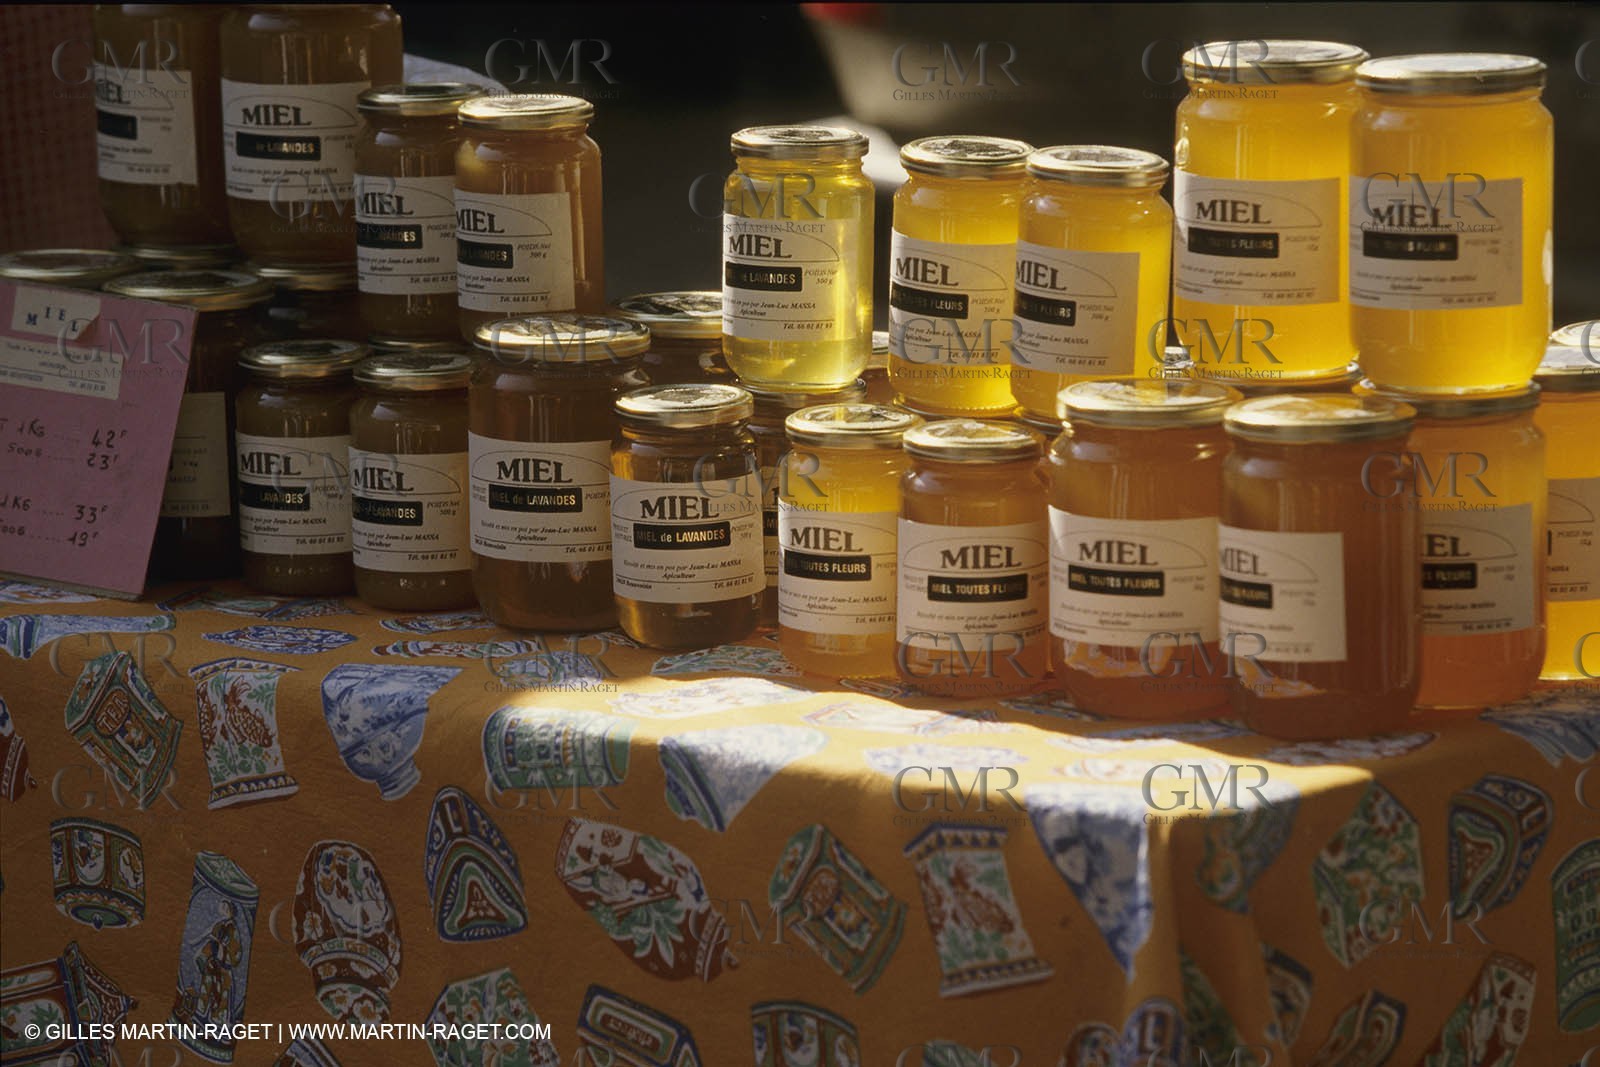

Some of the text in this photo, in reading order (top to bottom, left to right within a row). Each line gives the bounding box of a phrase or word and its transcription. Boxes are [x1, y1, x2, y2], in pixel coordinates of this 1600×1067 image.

[241, 104, 312, 126] MIEL
[456, 209, 505, 233] MIEL
[1196, 200, 1272, 225] MIEL
[1371, 203, 1452, 229] MIEL
[729, 234, 792, 259] MIEL
[895, 257, 959, 286] MIEL
[1016, 260, 1067, 290] MIEL
[240, 452, 301, 475] MIEL
[496, 458, 573, 483] MIEL
[354, 467, 414, 492] MIEL
[527, 494, 576, 506] LAVANDES
[640, 496, 719, 520] MIEL
[660, 533, 672, 543] de
[676, 528, 725, 542] LAVANDES
[790, 527, 863, 553] MIEL
[940, 545, 1022, 570] MIEL
[1079, 540, 1159, 566] MIEL
[832, 563, 866, 574] FLEURS
[956, 584, 990, 595] TOUTES
